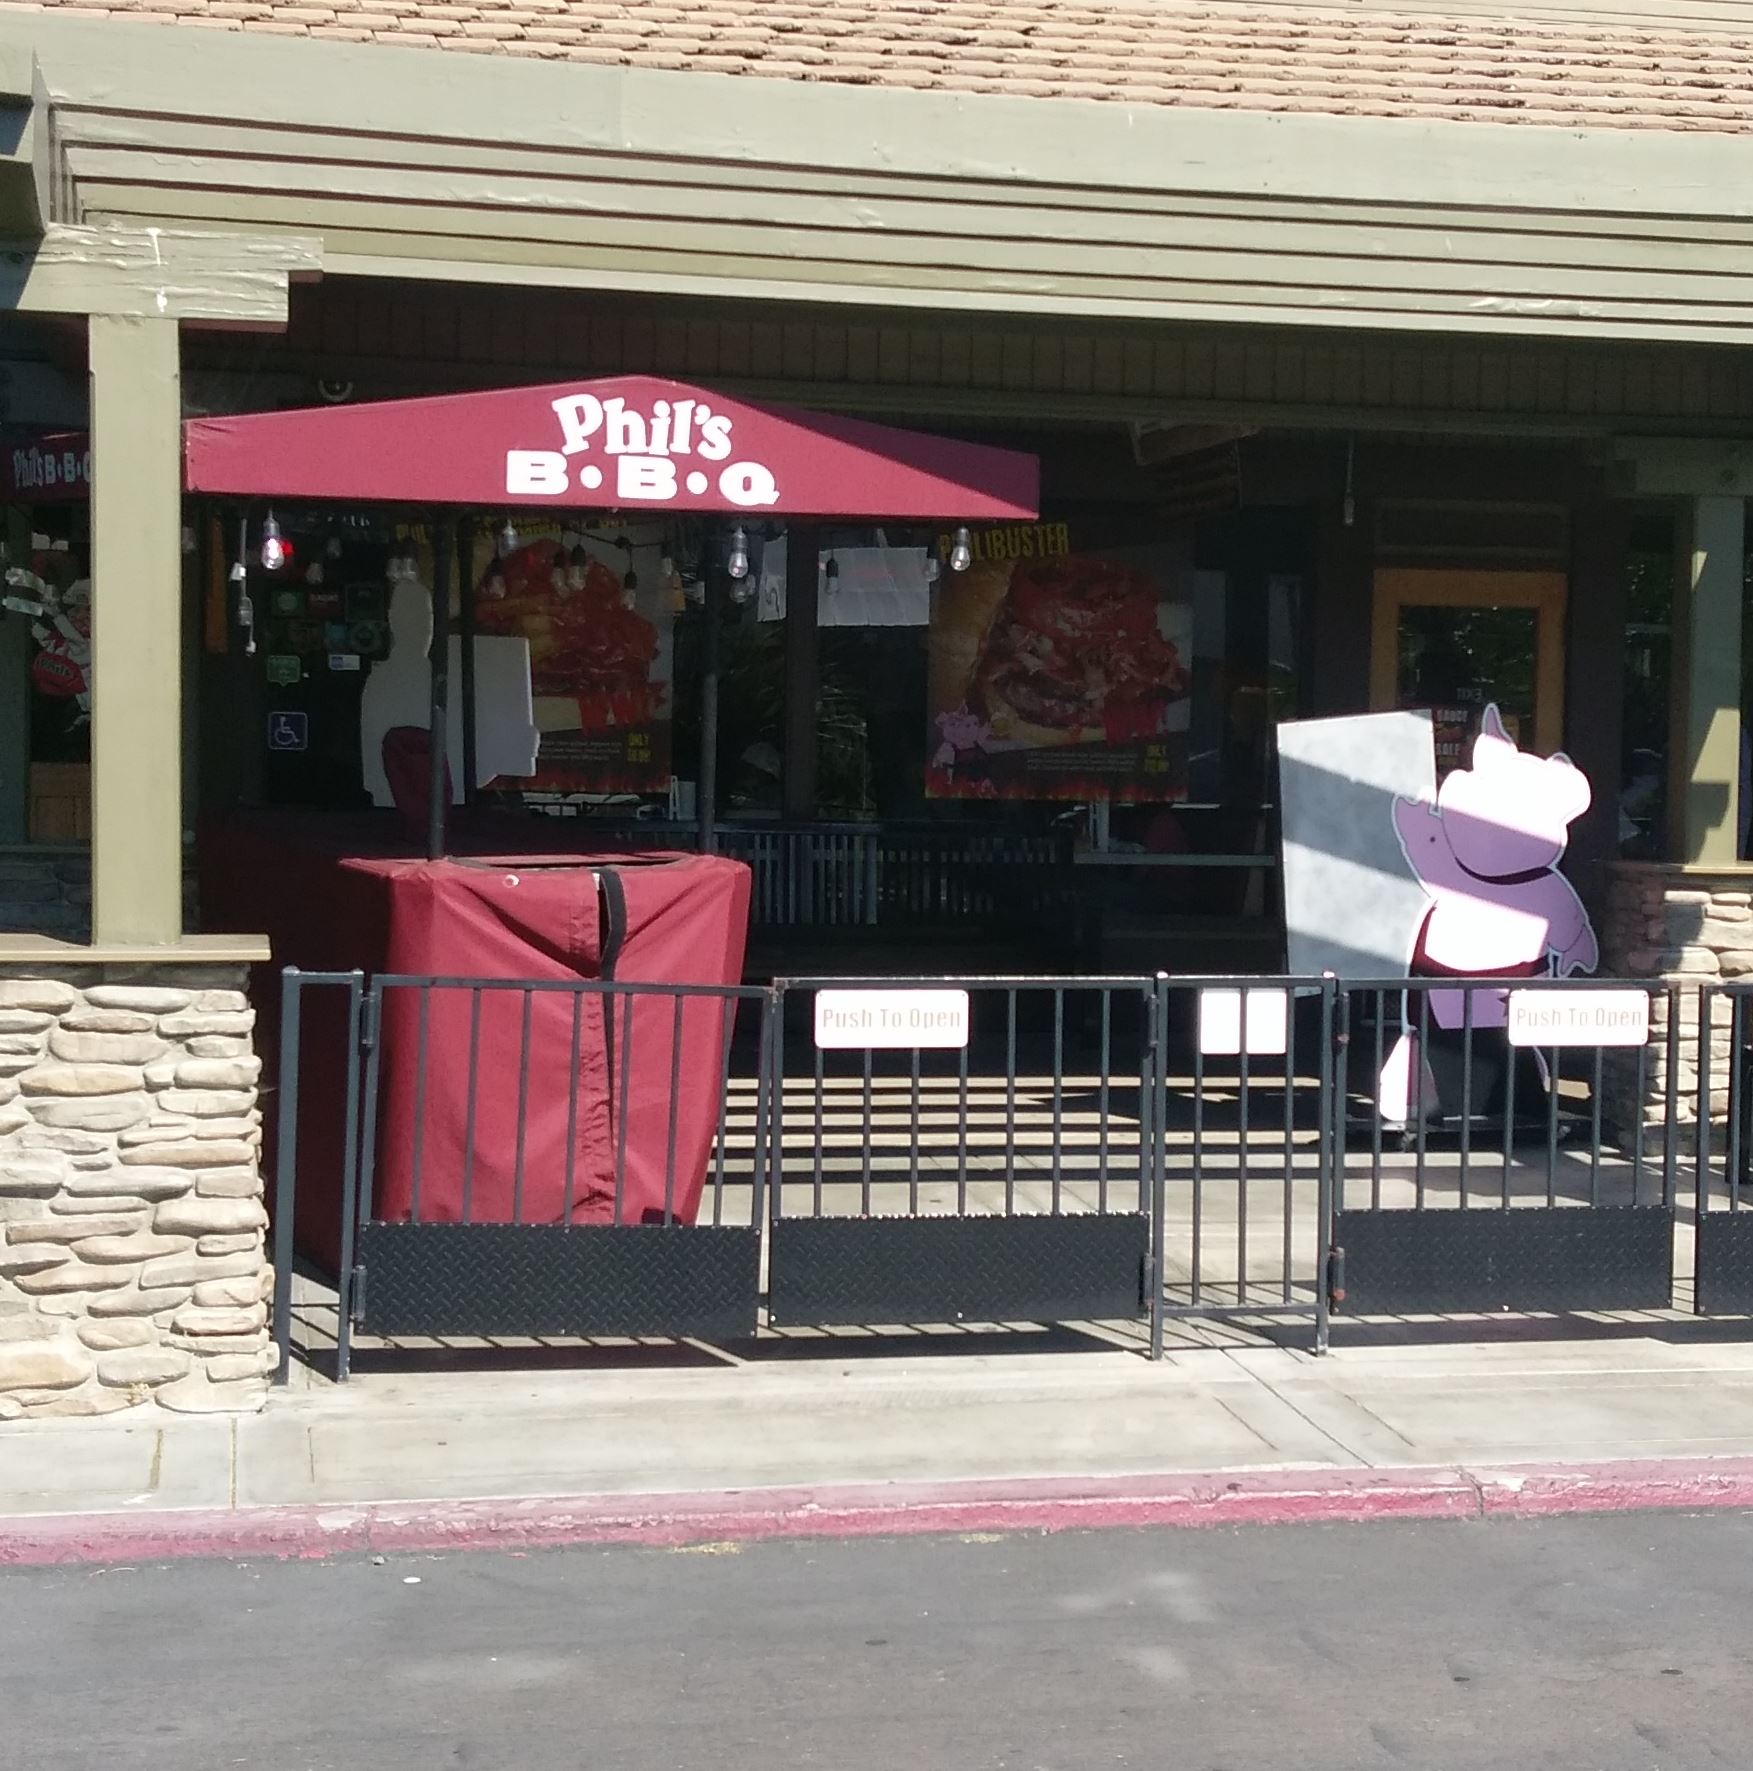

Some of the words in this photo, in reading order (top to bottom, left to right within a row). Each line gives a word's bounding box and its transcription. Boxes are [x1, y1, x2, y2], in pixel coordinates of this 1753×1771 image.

[551, 393, 733, 460] Phil's
[938, 522, 1069, 561] PLIBUSTER
[822, 1008, 872, 1028] Push
[880, 1008, 902, 1028] To
[909, 1008, 960, 1029] Open
[1516, 1007, 1561, 1027] Push
[1568, 1007, 1588, 1027] To
[1595, 1007, 1642, 1027] Open
